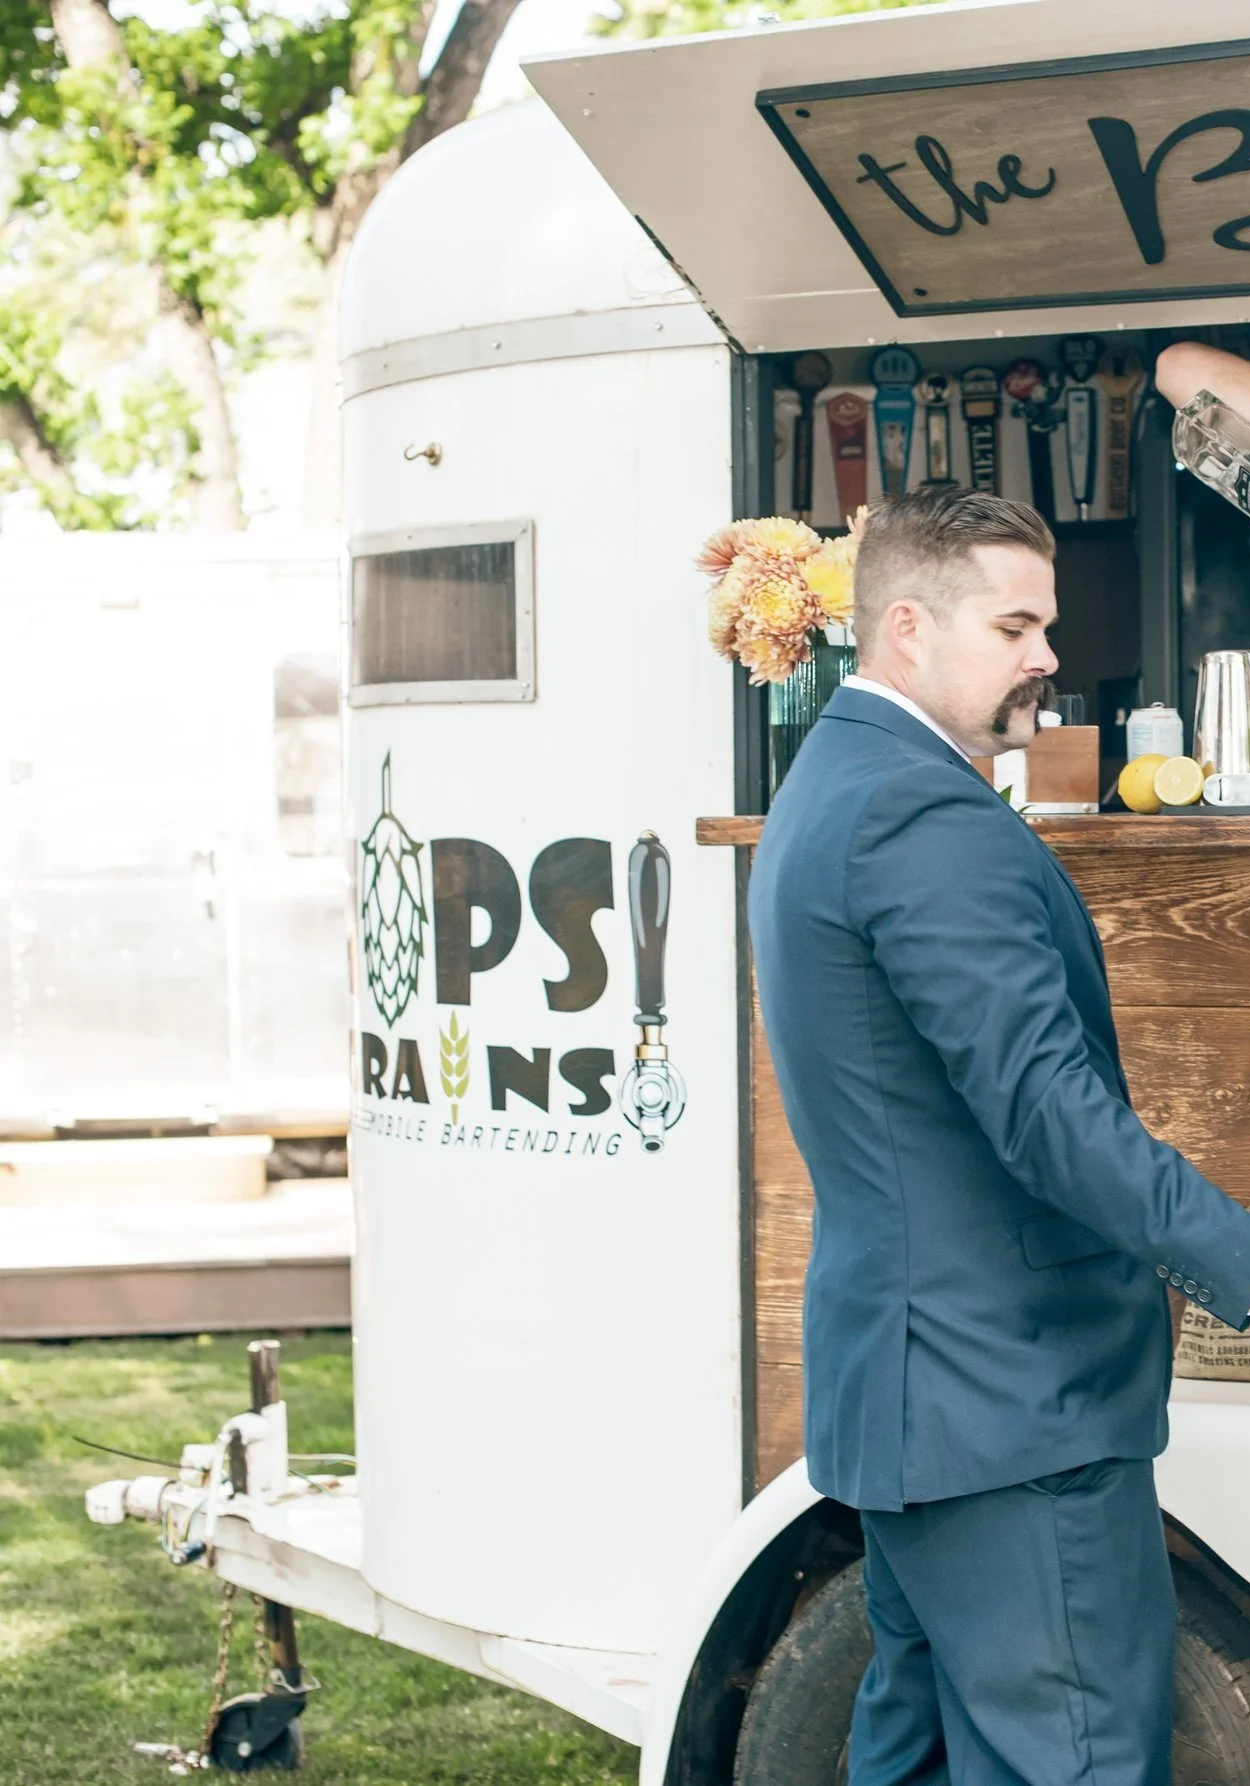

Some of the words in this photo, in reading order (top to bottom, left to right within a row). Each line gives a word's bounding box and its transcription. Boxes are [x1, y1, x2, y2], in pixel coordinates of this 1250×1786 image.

[856, 134, 1056, 238] the
[361, 1018, 616, 1118] RAINS
[440, 1122, 623, 1157] BARTENDING
